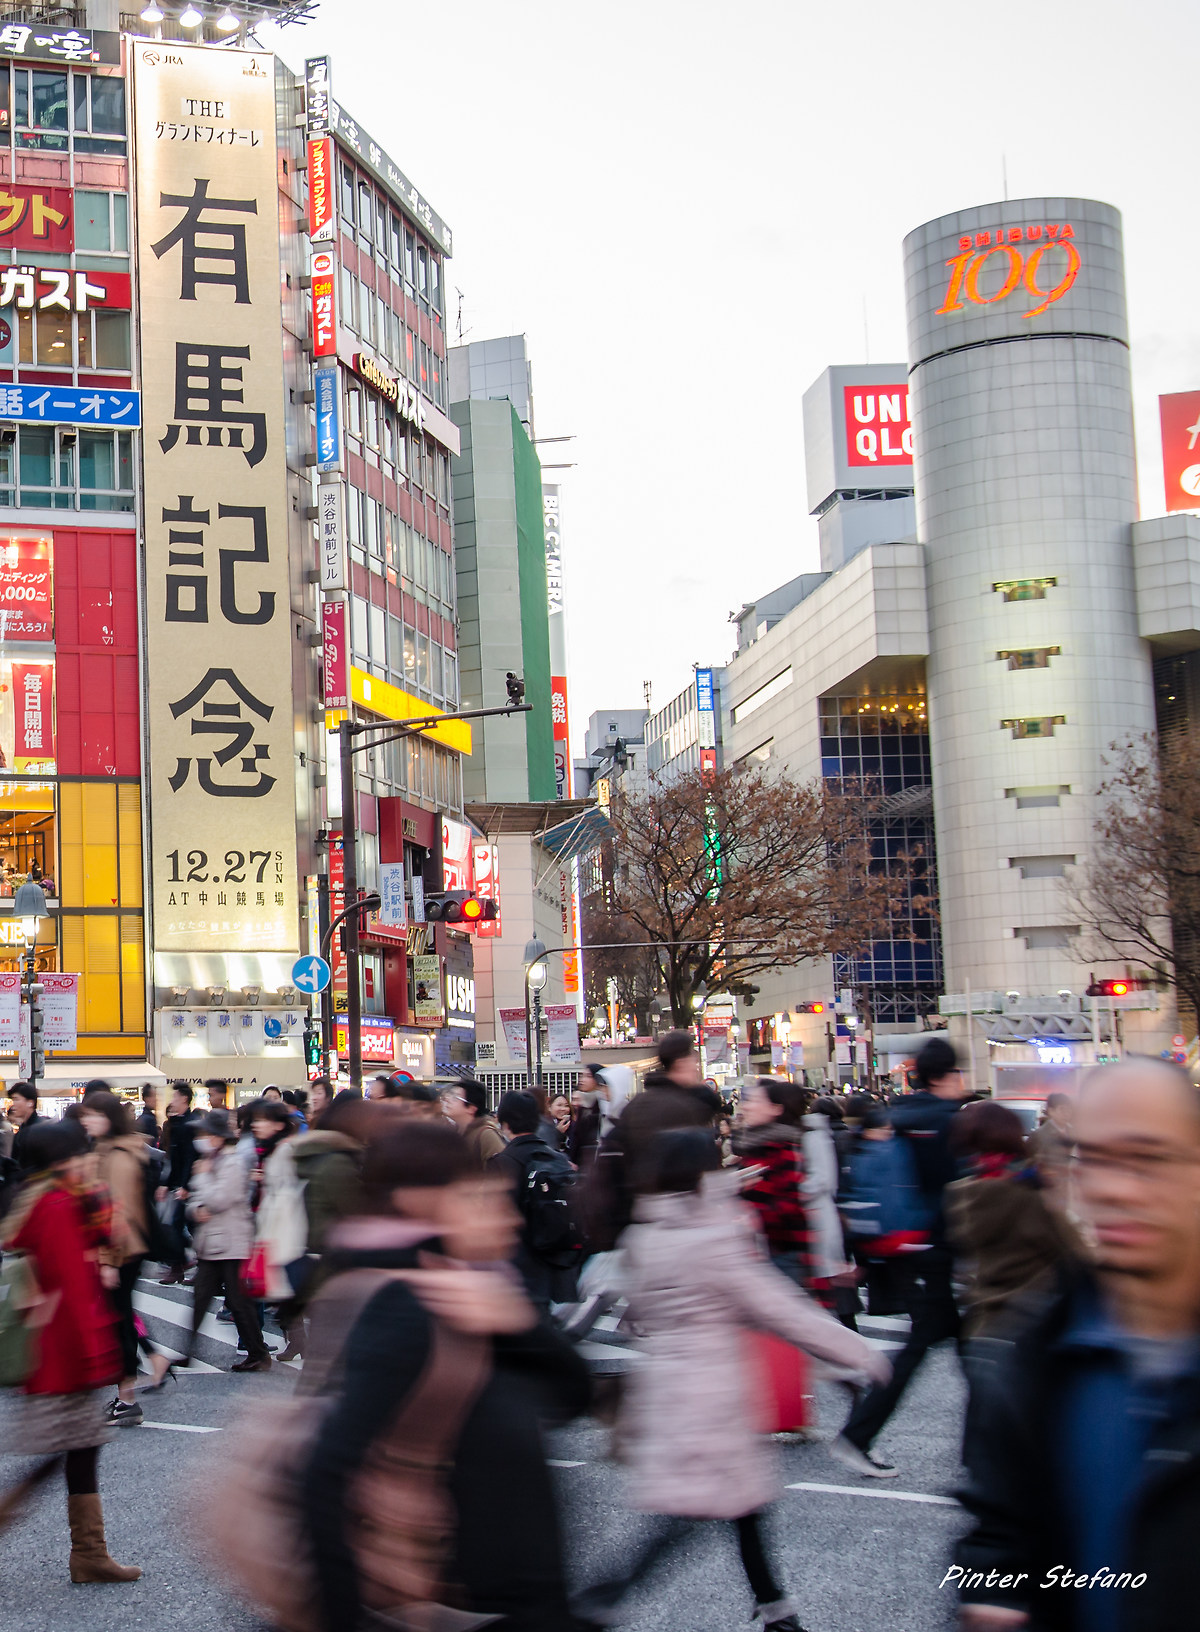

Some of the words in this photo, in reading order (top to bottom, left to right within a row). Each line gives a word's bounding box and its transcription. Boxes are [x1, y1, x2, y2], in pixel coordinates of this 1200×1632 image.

[164, 54, 184, 65] JRA
[186, 98, 224, 119] THE
[155, 121, 260, 147] グランドフィナーレ
[313, 141, 325, 178] プライス
[313, 179, 326, 227] コンタクト
[319, 231, 331, 240] 8F
[958, 224, 1075, 251] SHIBUYA
[0, 266, 106, 312] ガスト
[935, 239, 1081, 319] 109
[316, 296, 332, 346] ガスト
[321, 378, 335, 463] 英会話イーオン
[397, 378, 427, 430] ガスト
[853, 394, 912, 424] UNI
[323, 463, 334, 472] 6F
[150, 178, 278, 797] 有馬記念
[543, 495, 559, 528] BIC
[324, 494, 338, 580] 渋谷駅前ビル
[324, 603, 344, 615] 5F
[24, 672, 43, 749] 毎日開催
[551, 691, 566, 723] 免税
[166, 849, 272, 883] 12.27
[275, 850, 283, 884] SUN
[168, 891, 189, 906] AT
[199, 891, 284, 907] 中山競馬場
[390, 868, 402, 919] 渋谷駅前
[447, 974, 476, 1014] USH
